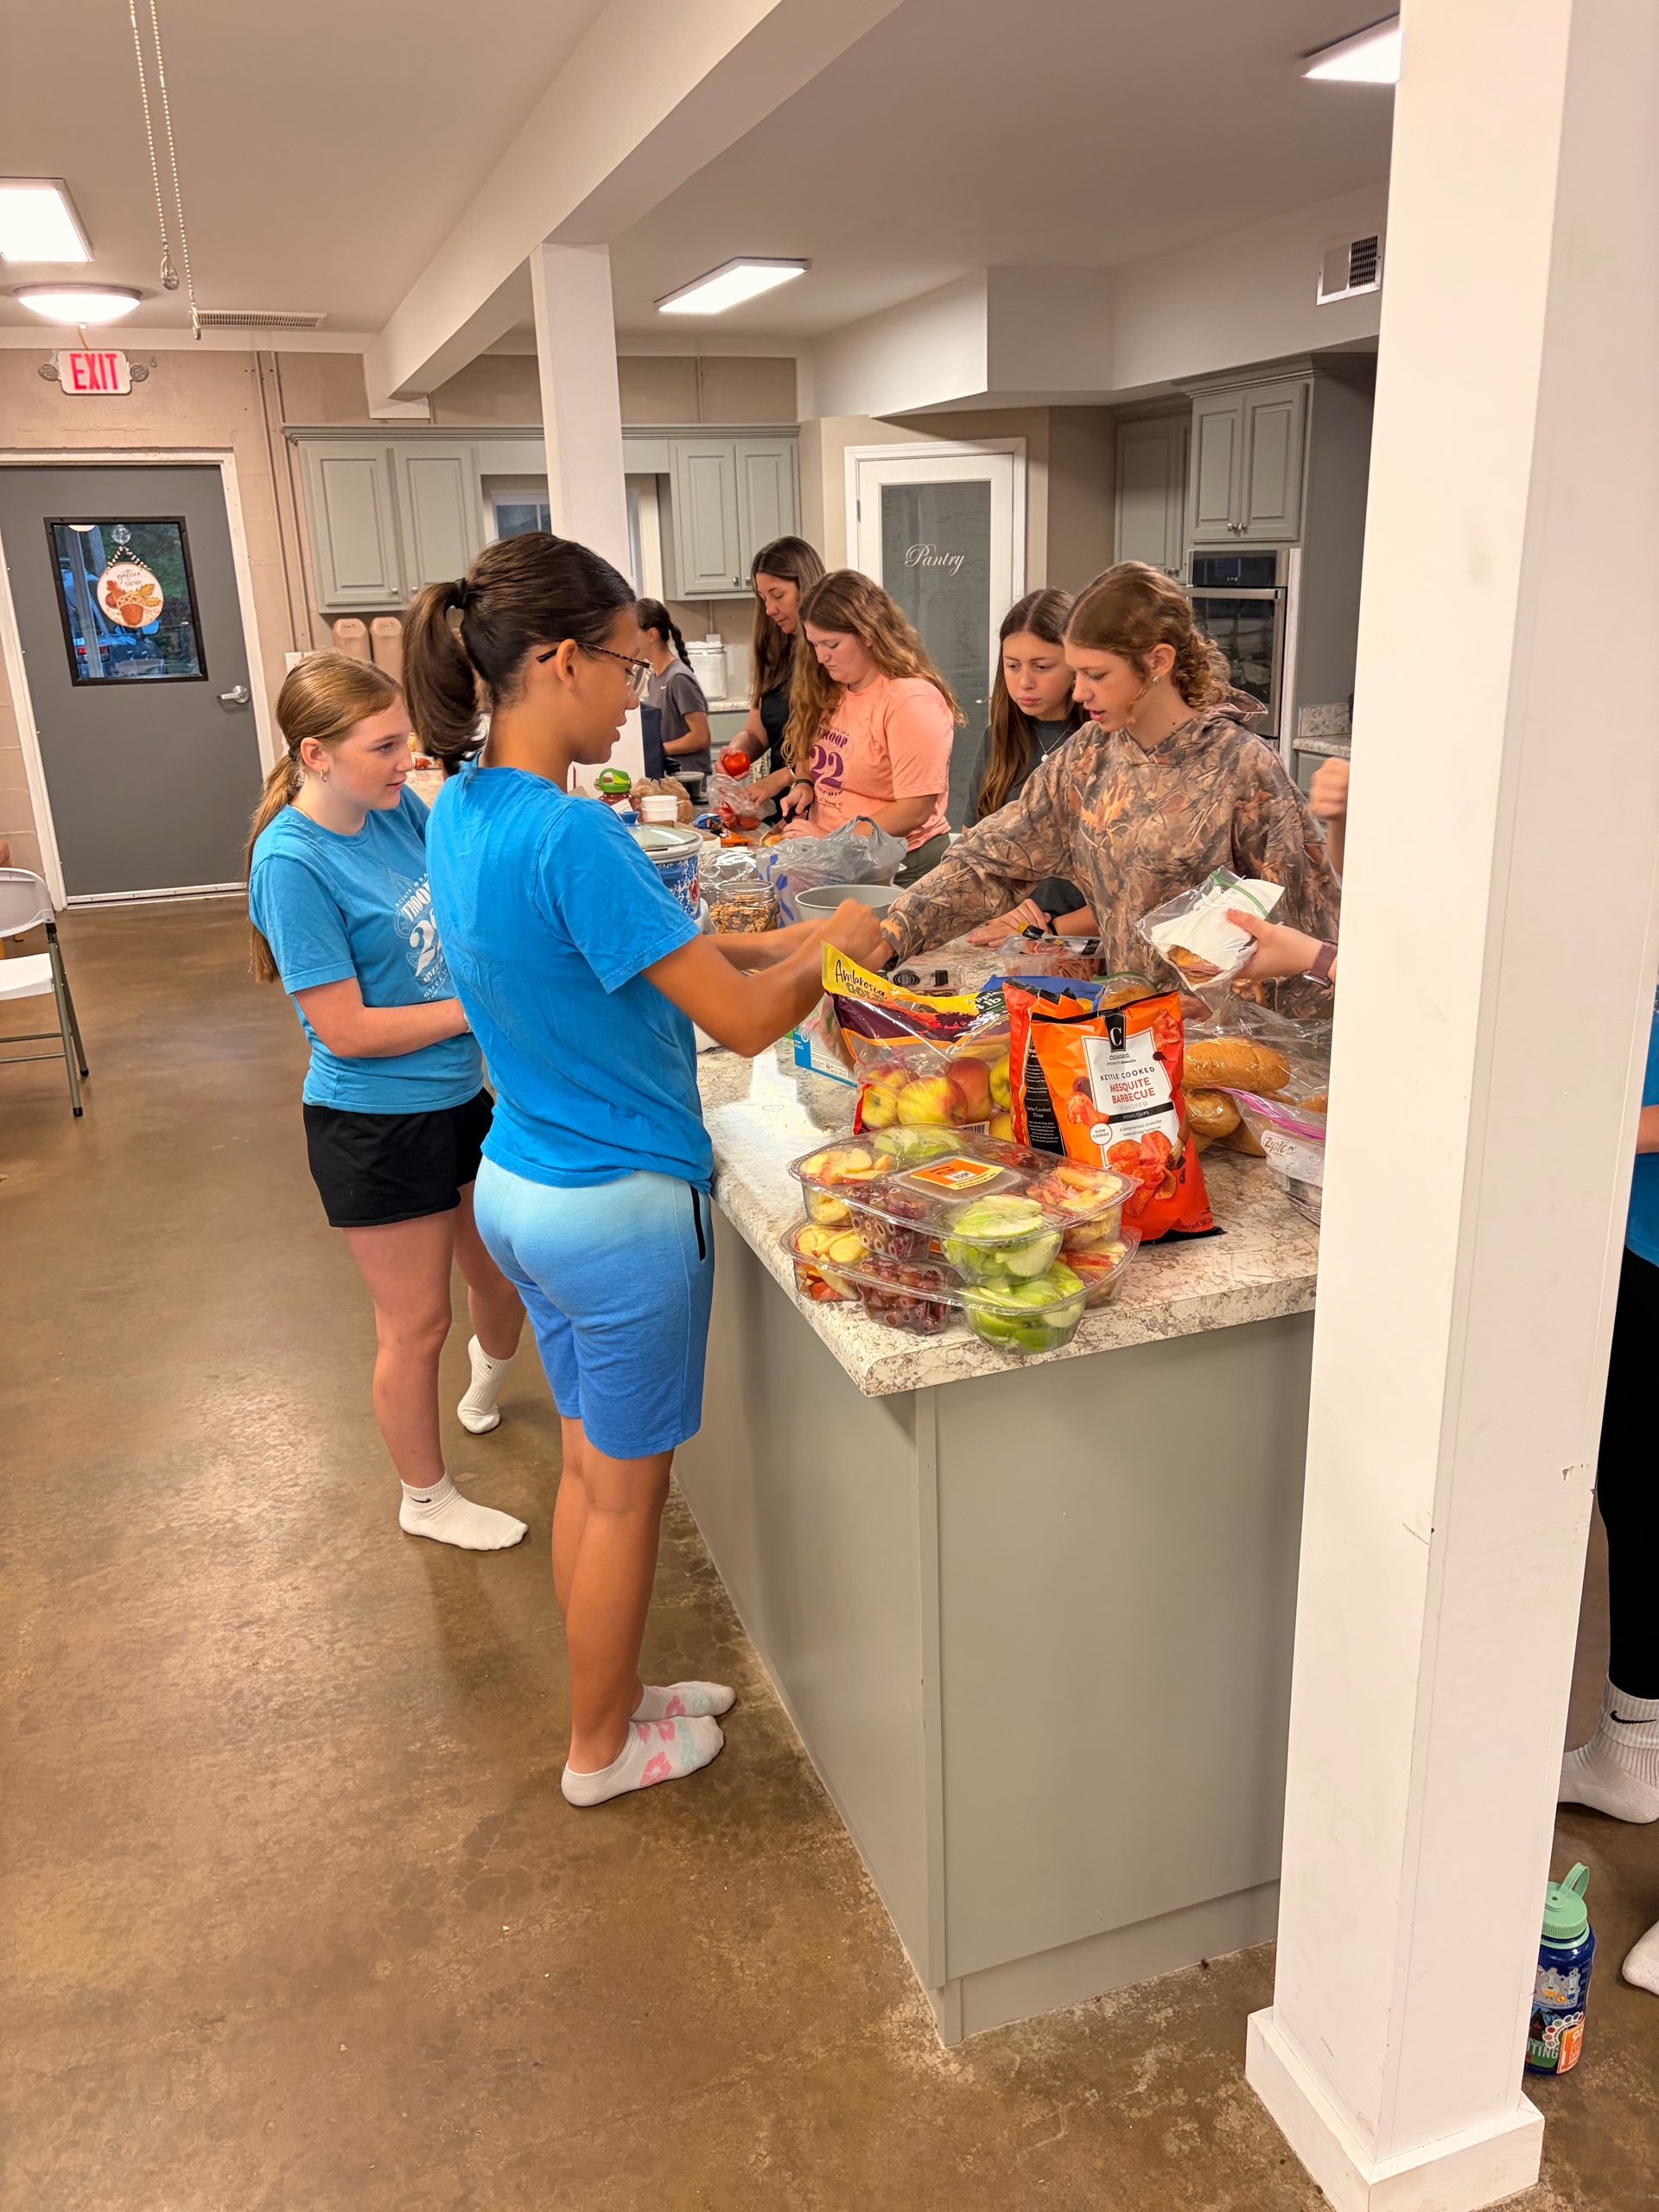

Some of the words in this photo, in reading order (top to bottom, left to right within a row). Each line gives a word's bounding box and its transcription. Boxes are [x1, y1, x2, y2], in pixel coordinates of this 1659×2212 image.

[69, 353, 118, 390] EXIT
[905, 543, 965, 576] Pantry
[117, 569, 141, 584] gather
[809, 744, 844, 788] 22
[835, 960, 887, 1000] Ambrosia
[846, 982, 885, 1002] GOLD
[1109, 1027, 1122, 1046] C
[1100, 1073, 1120, 1082] KETTLE
[1121, 1066, 1155, 1079] COOKED
[1109, 1077, 1151, 1093] MESQUITE
[1111, 1087, 1156, 1104] BARBECUE
[1120, 1101, 1148, 1111] FLAVORED
